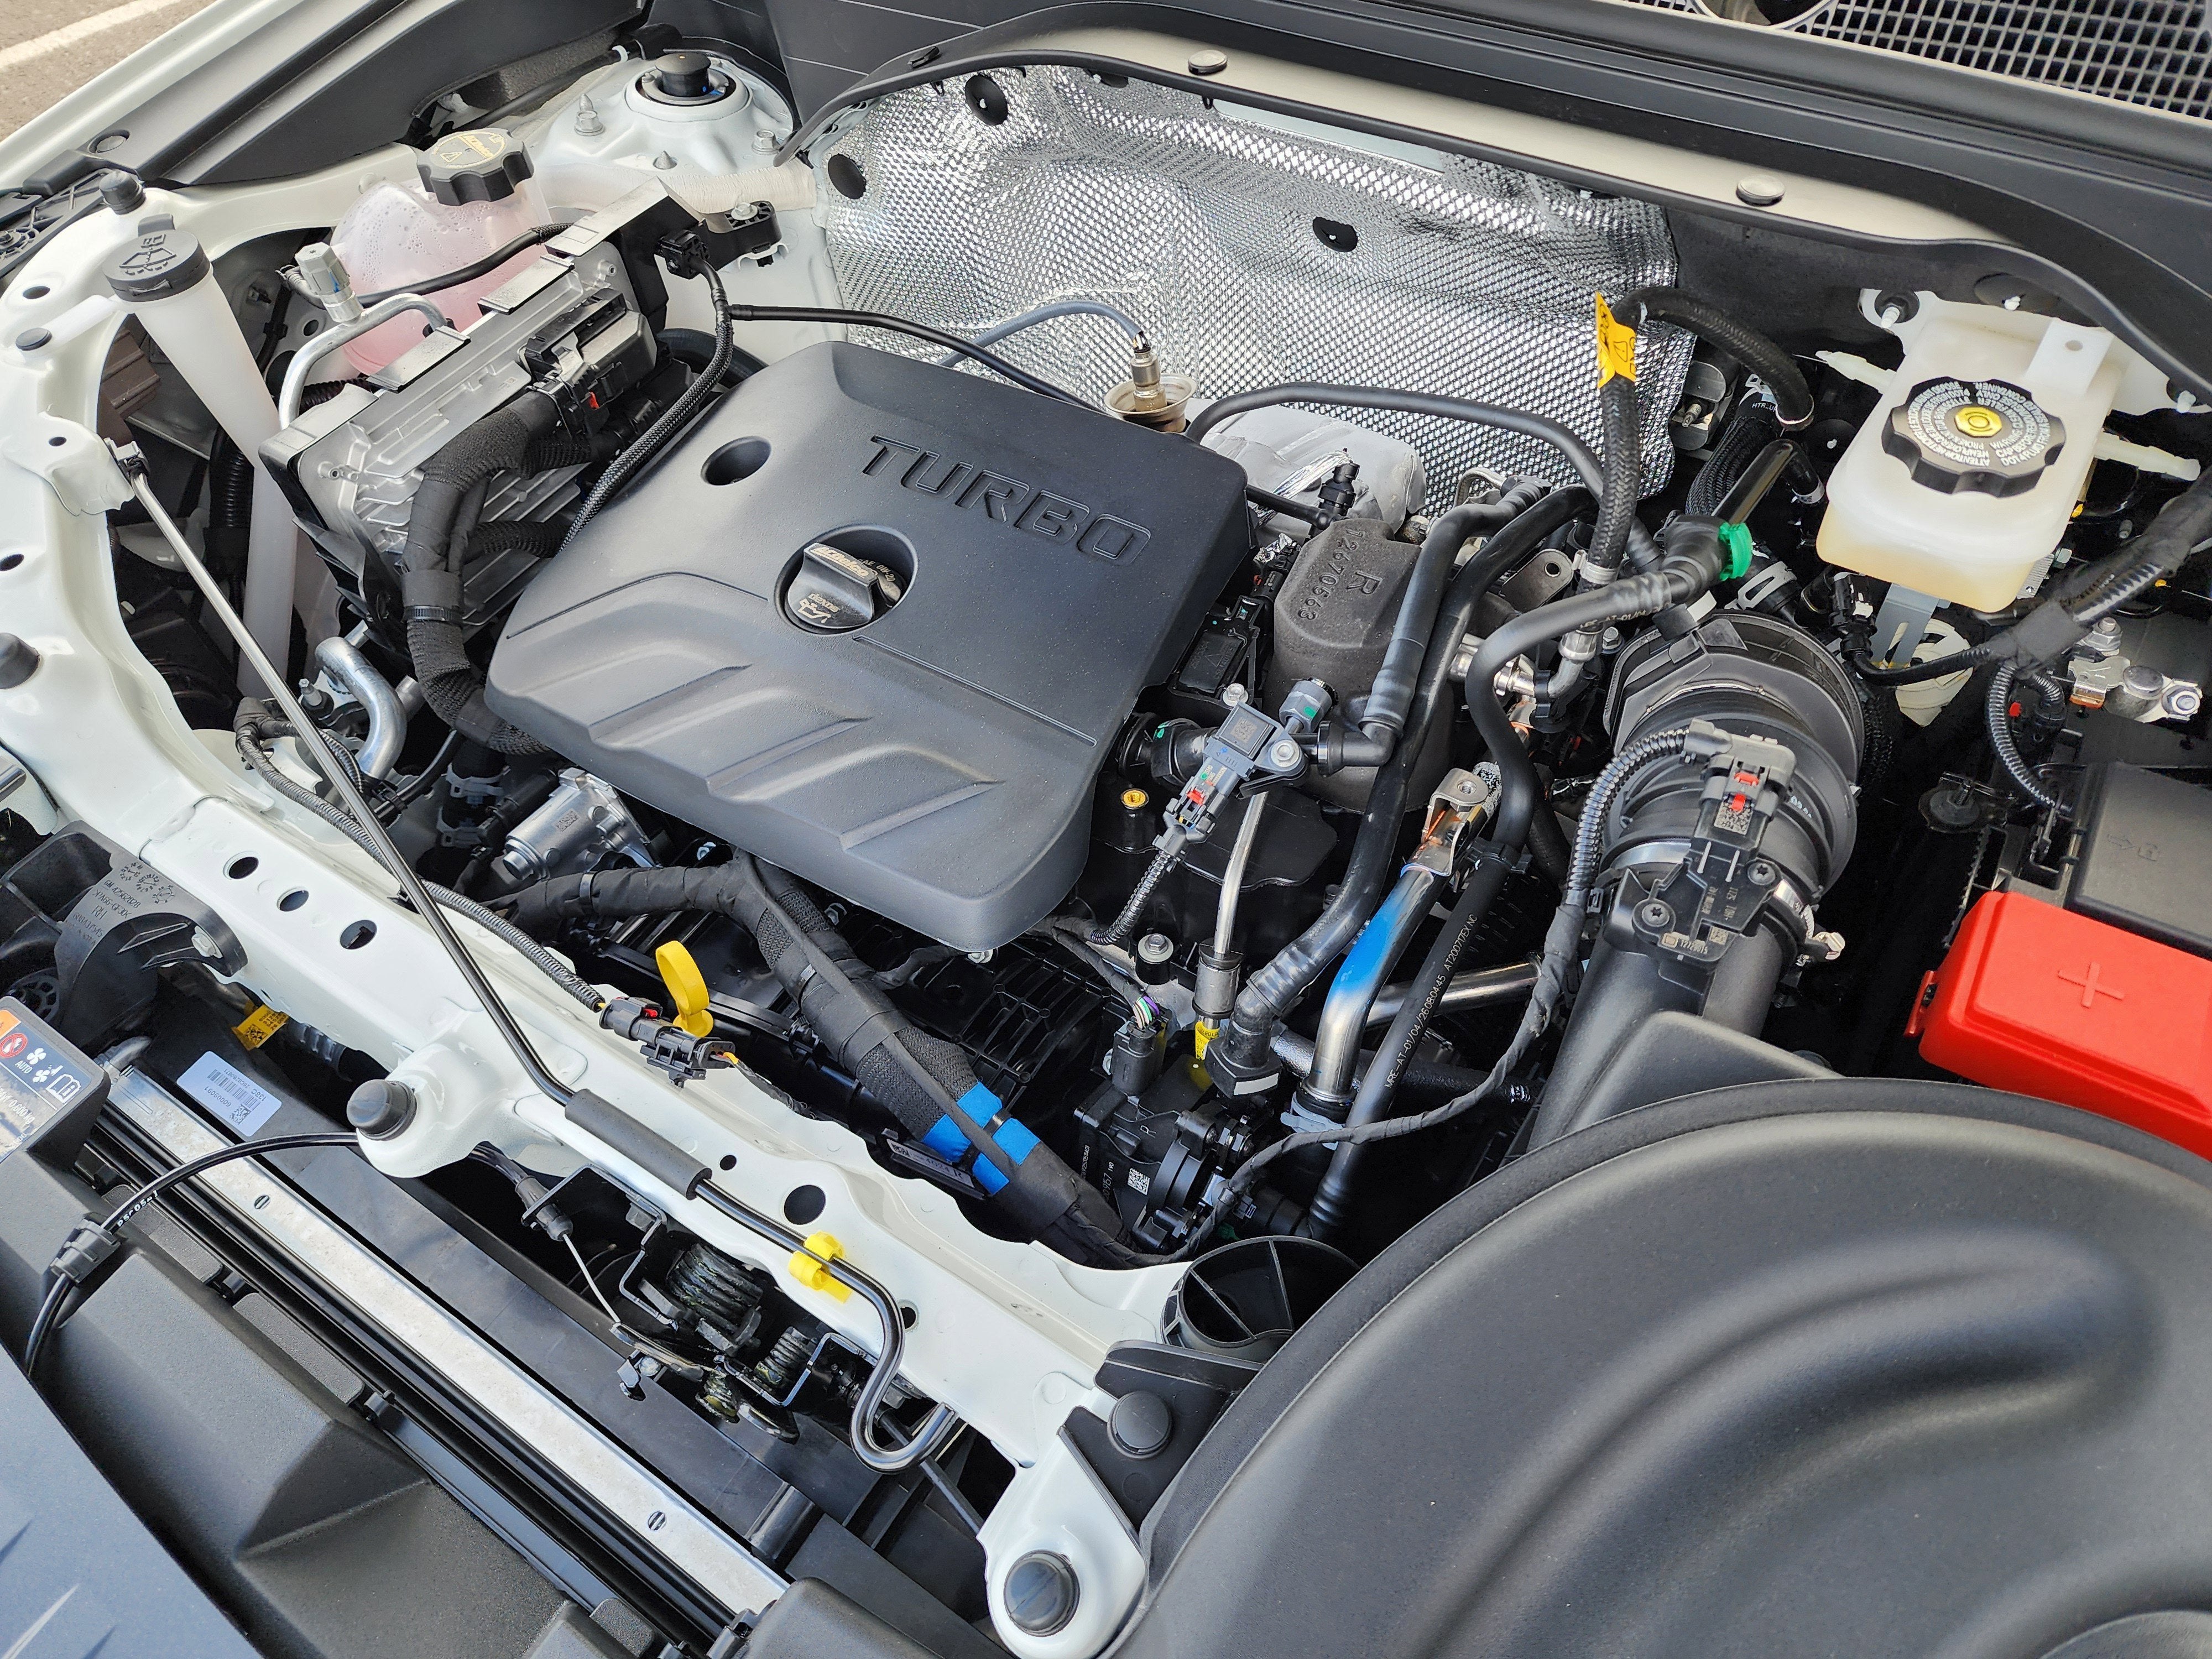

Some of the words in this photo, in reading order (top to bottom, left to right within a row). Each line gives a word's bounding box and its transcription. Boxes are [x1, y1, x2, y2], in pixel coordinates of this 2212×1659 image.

[1948, 390, 1964, 400] DOT
[1976, 390, 2001, 400] ONLY
[1999, 395, 2018, 409] USE
[1990, 429, 2022, 450] WARNING
[1945, 449, 1990, 467] ATTENTION
[1996, 447, 2014, 457] CAP
[2001, 456, 2021, 466] DOT
[2022, 443, 2045, 458] FLUID
[863, 435, 1151, 565] TURBO
[811, 546, 870, 576] ACDelco
[1298, 529, 1365, 620] 12670563
[1345, 570, 1383, 595] R
[808, 593, 840, 613] dexos
[91, 905, 108, 920] RH
[1443, 925, 1472, 972] AT200717EX
[1465, 914, 1478, 931] NC
[15, 1061, 33, 1074] AUTO
[251, 1088, 267, 1102] 138C
[1140, 1125, 1156, 1138] R
